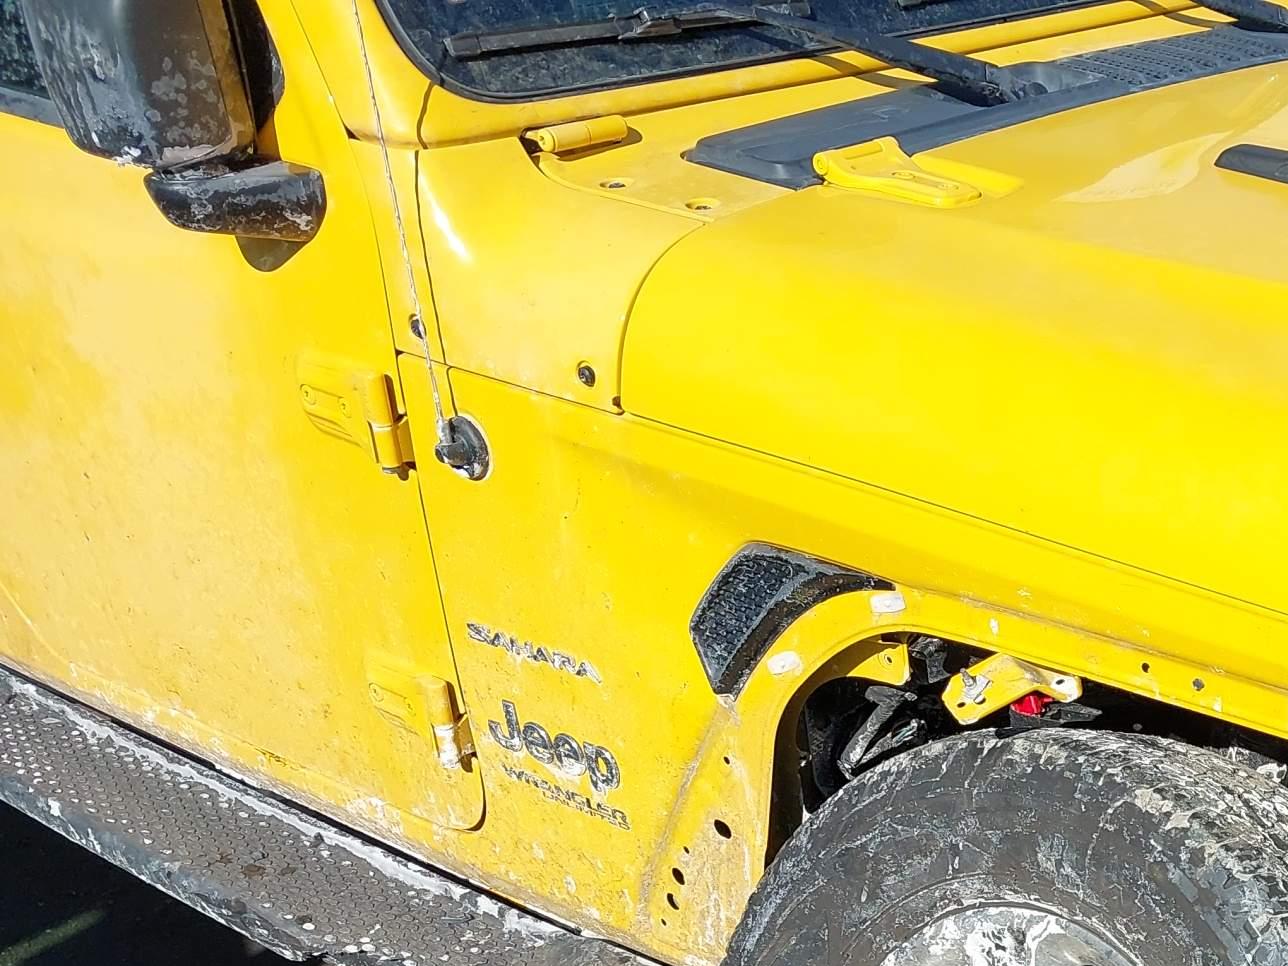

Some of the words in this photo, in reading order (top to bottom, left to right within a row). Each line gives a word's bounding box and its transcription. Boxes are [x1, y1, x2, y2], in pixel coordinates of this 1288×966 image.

[467, 623, 602, 683] SAHARA
[487, 699, 620, 794] Jeep
[501, 762, 629, 824] WRANGLER
